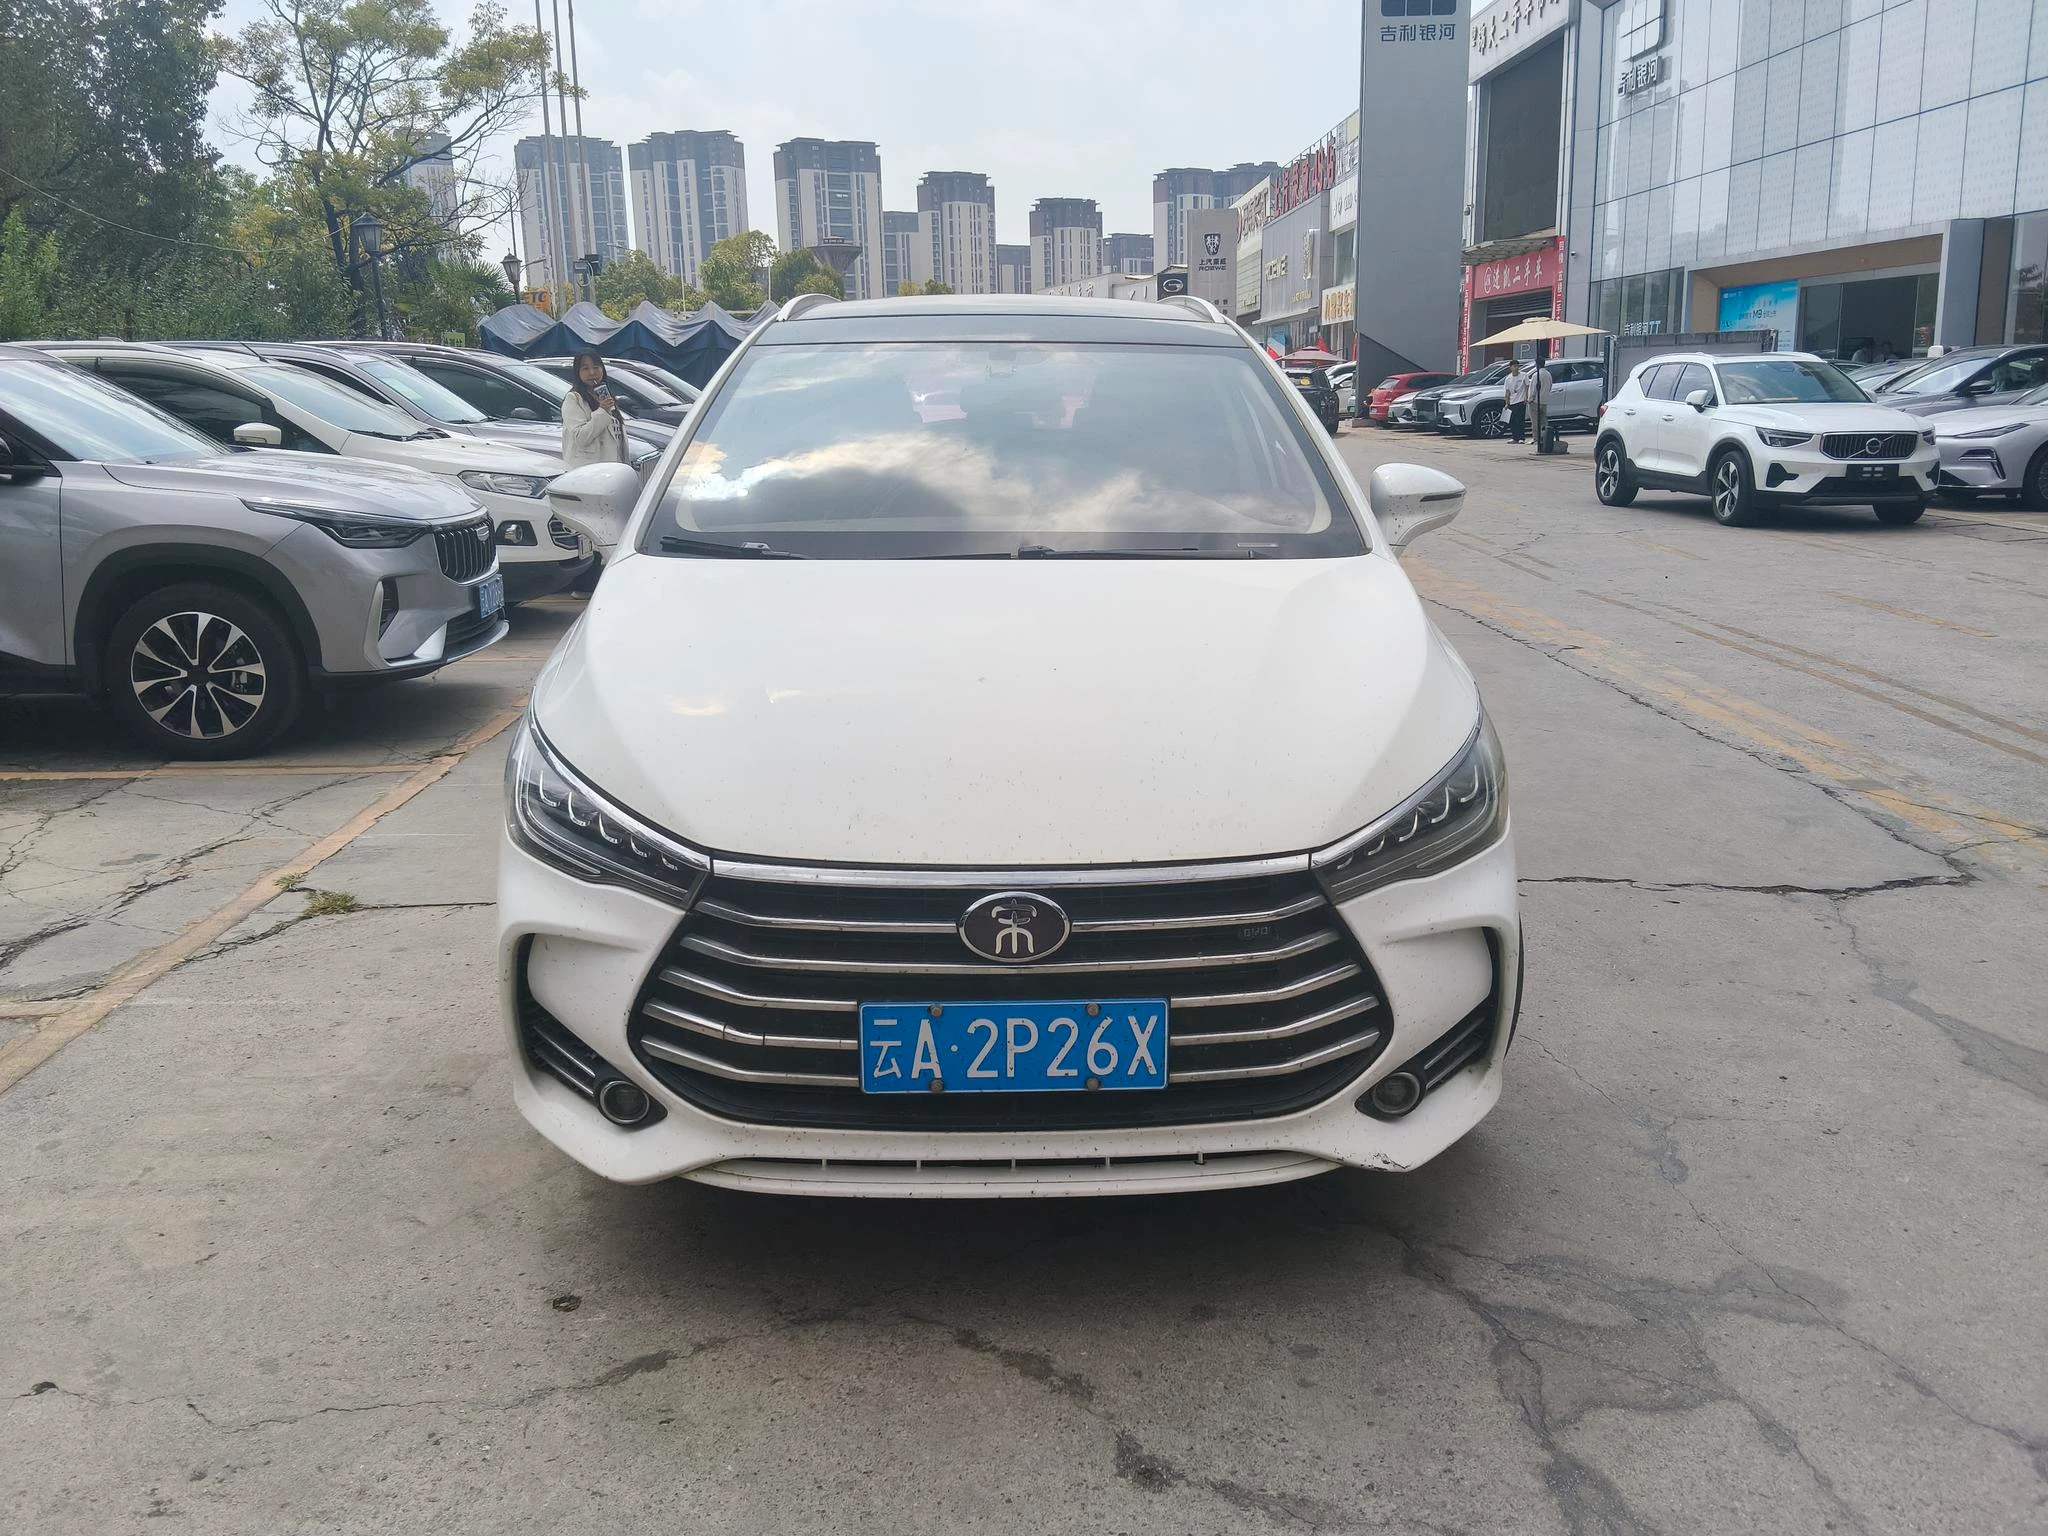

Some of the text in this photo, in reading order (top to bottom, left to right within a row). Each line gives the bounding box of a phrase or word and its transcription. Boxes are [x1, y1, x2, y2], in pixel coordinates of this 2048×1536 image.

[1380, 24, 1456, 42] 吉利银河
[1617, 57, 1659, 97] 吉利银河
